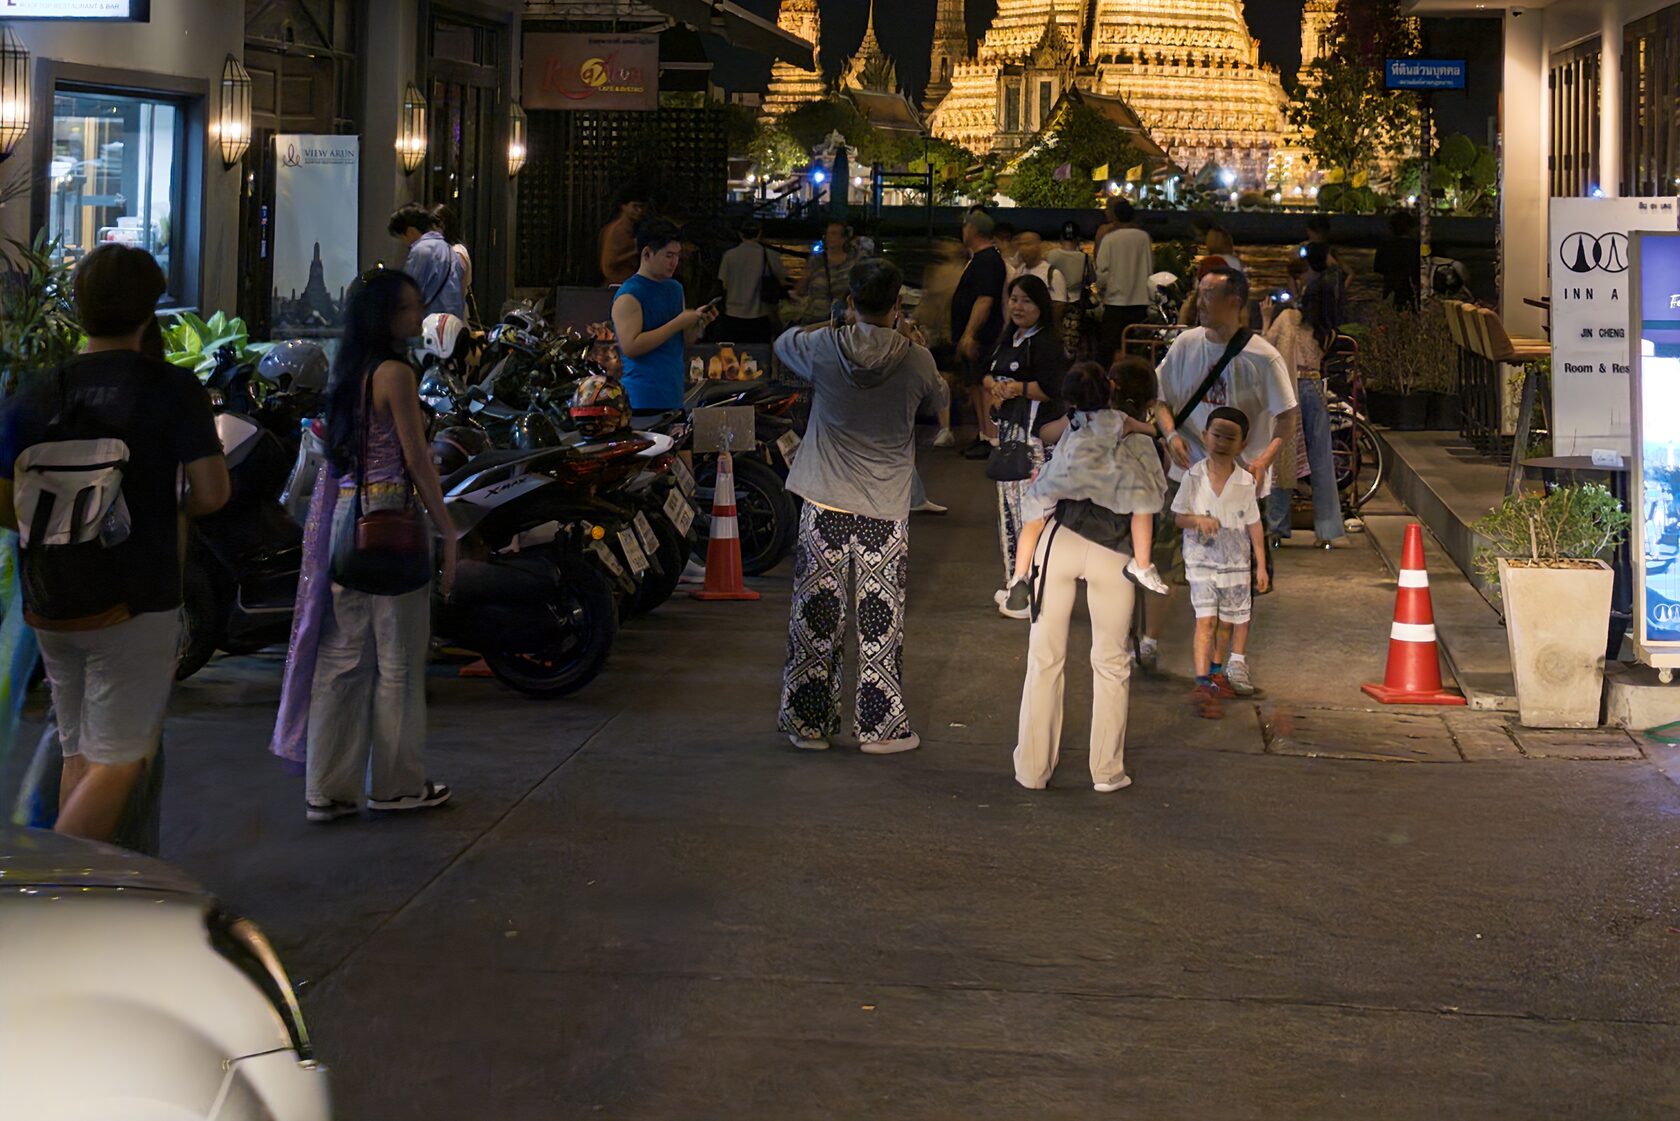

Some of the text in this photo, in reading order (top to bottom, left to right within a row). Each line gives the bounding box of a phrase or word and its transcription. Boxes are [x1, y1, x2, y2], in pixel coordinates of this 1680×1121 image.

[304, 149, 355, 157] VIEW ARUN
[1564, 288, 1619, 300] INN A
[1599, 329, 1625, 338] CHENG
[1564, 363, 1593, 374] Room
[1599, 363, 1607, 374] &
